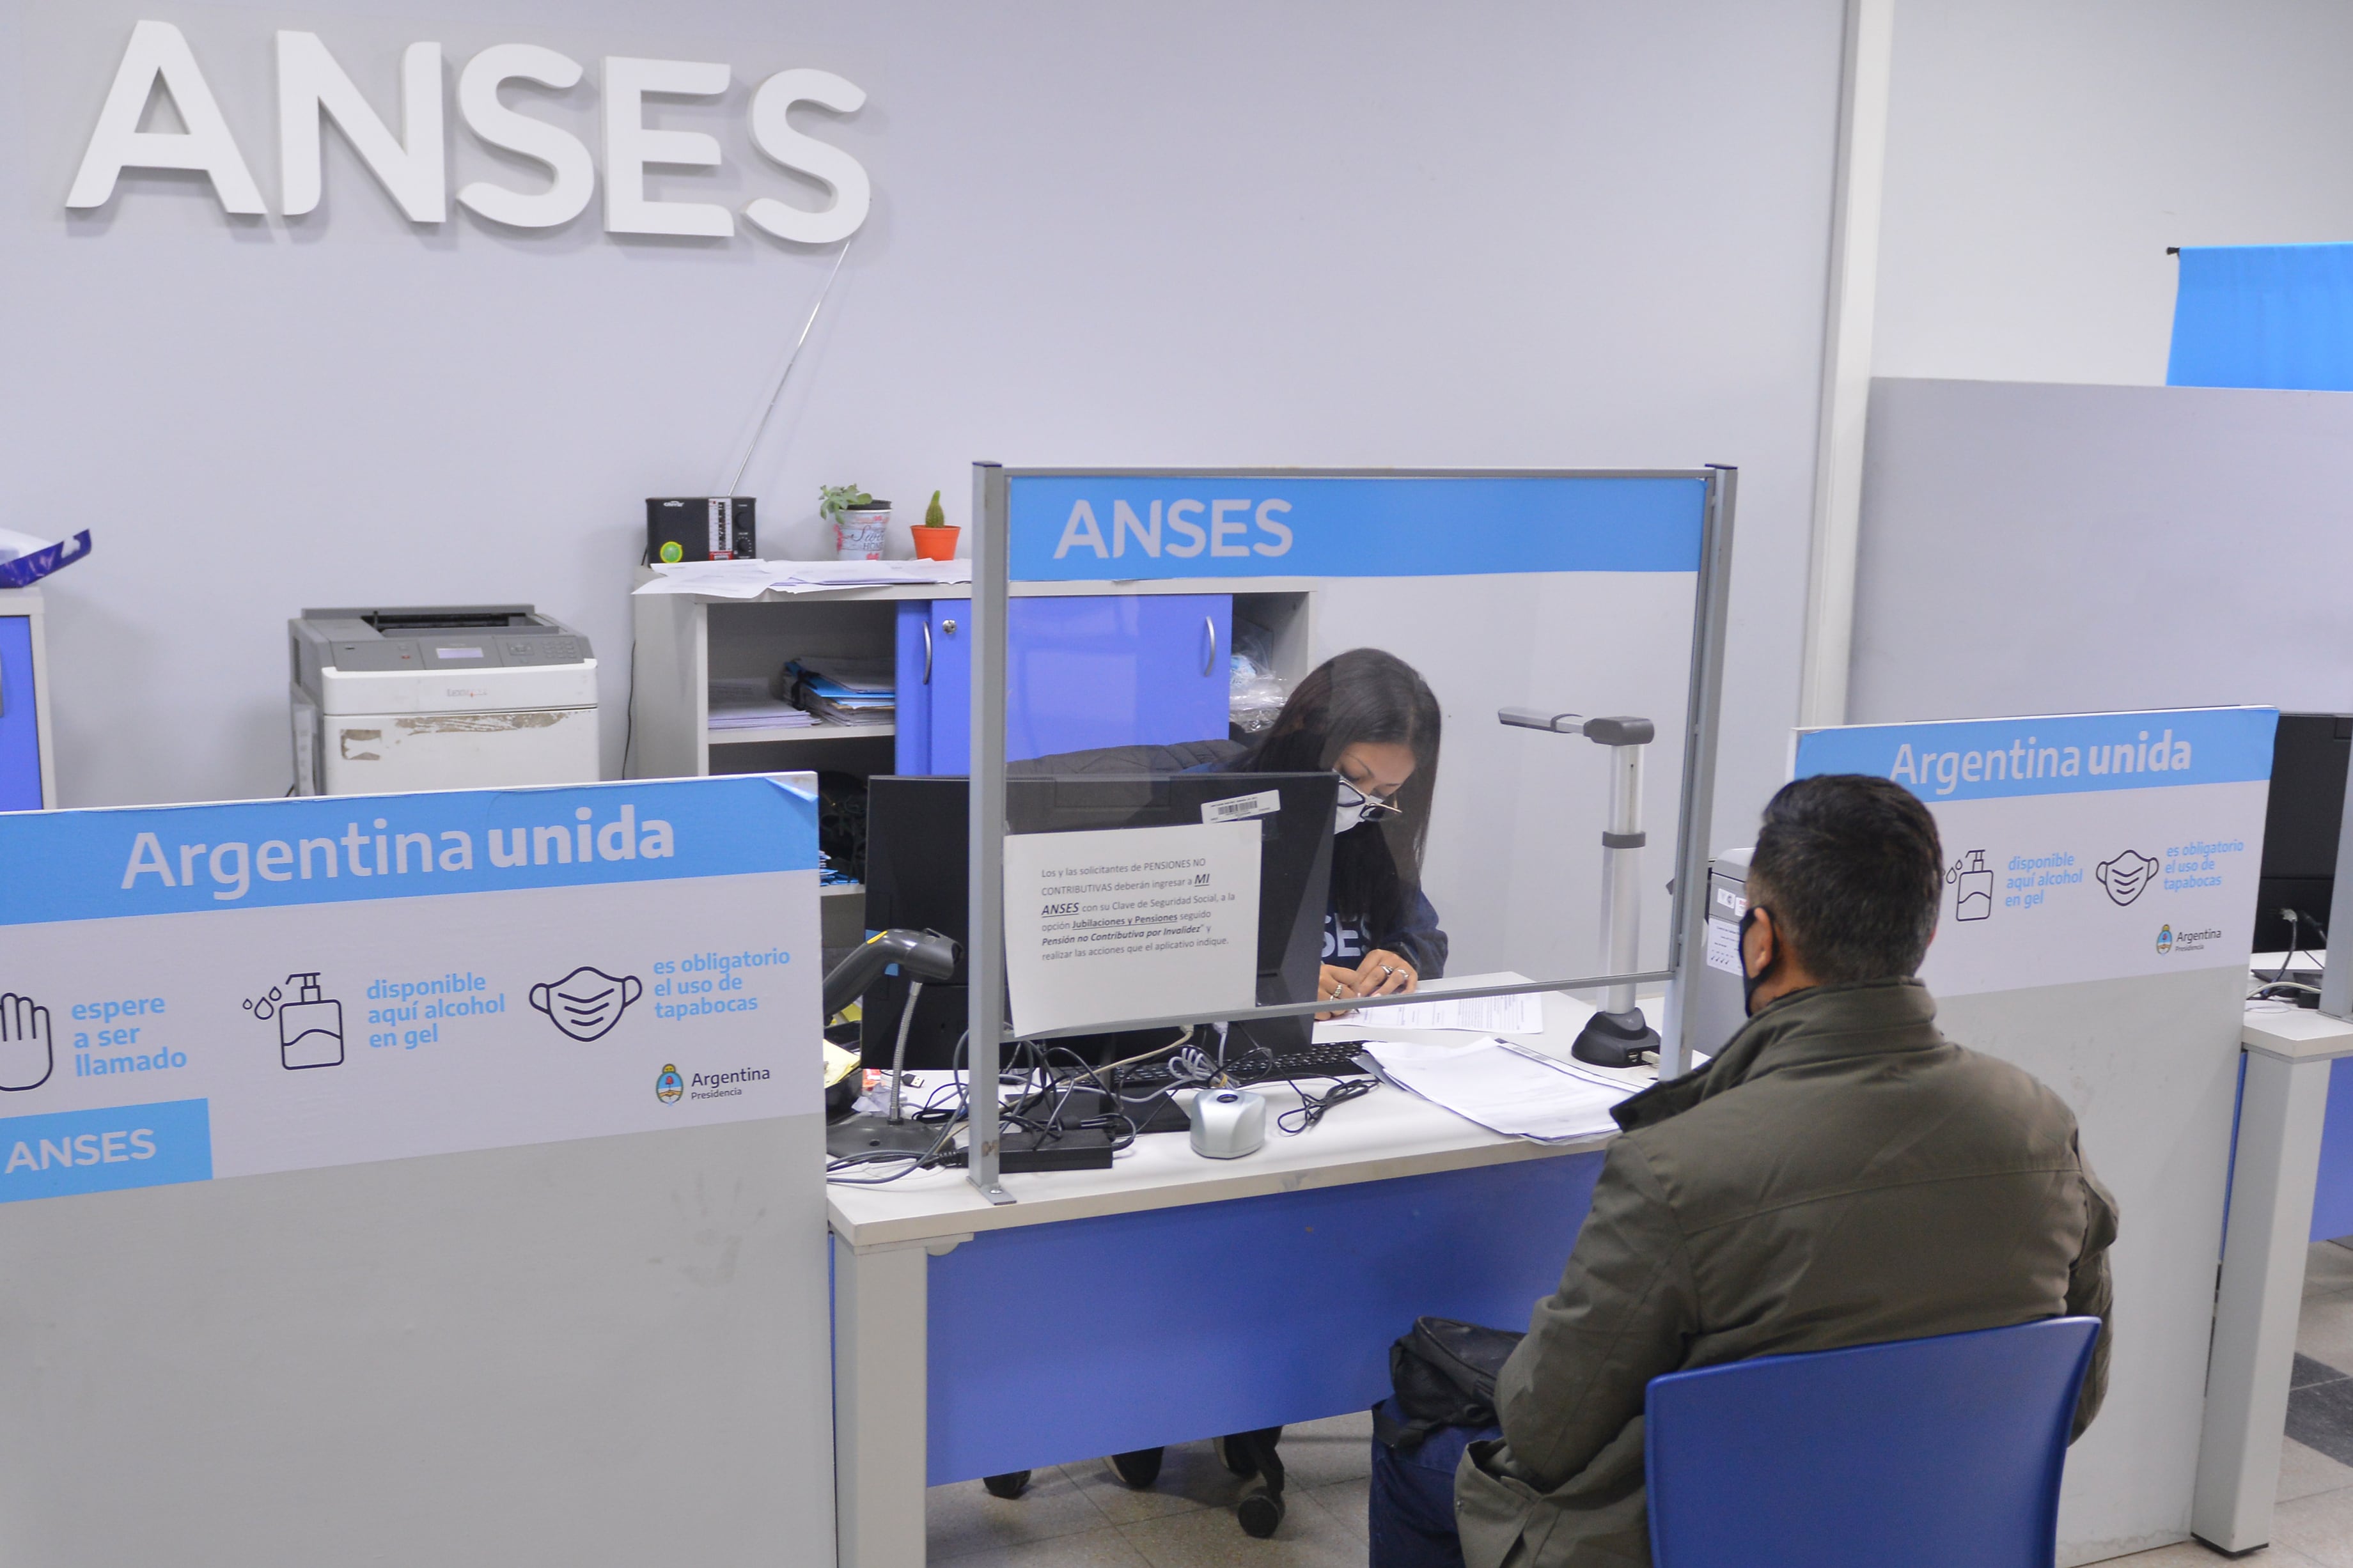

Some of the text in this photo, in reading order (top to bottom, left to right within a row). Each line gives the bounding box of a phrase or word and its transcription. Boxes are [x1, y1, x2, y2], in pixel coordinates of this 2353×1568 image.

[66, 20, 871, 243] ANSES
[1053, 499, 1293, 559] ANSES
[1890, 729, 2191, 795] Argentina unida
[121, 804, 674, 900] Argentina unida
[2166, 839, 2244, 857] es obligatorio
[1080, 866, 1128, 875] solicitantes
[1144, 861, 1191, 871] PENSIONES
[2008, 852, 2075, 873] disponible
[2164, 857, 2215, 874] el uso de
[1042, 883, 1112, 896] CONTRIBUTIVAS
[1114, 880, 1150, 891] deberán
[1152, 879, 1185, 889] ingresar
[1194, 874, 1210, 884] MI
[2006, 869, 2083, 891] aquí alcohol
[2164, 875, 2221, 892] tapabocas
[1041, 902, 1079, 915] ANSES
[1113, 901, 1135, 910] Clave
[1150, 896, 1191, 908] Seguridad
[1194, 894, 1219, 903] Social,
[2005, 889, 2044, 909] en gel
[1042, 922, 1070, 932] opción
[1072, 917, 1125, 928] Jubilaciones
[1135, 914, 1178, 923] Pensiones
[1180, 911, 1211, 920] seguido
[1042, 936, 1075, 946] Pensión
[1091, 930, 1144, 941] Contributiva
[1146, 929, 1161, 938] por
[2176, 929, 2221, 944] Argentina
[1042, 951, 1072, 960] realizar
[1088, 947, 1125, 956] acciones
[1155, 941, 1194, 951] aplicativo
[1196, 938, 1229, 946] indique.
[653, 948, 790, 979] es obligatorio
[367, 972, 486, 1002] disponible
[654, 974, 742, 997] el uso de
[72, 998, 165, 1023] espere
[368, 993, 504, 1027] aquí alcohol
[655, 997, 758, 1021] tapabocas
[74, 1028, 140, 1048] a ser
[369, 1023, 438, 1050] en gel
[75, 1046, 187, 1076] llamado
[691, 1067, 770, 1089] Argentina
[691, 1089, 742, 1099] Presidencia
[5, 1129, 156, 1174] ANSES
